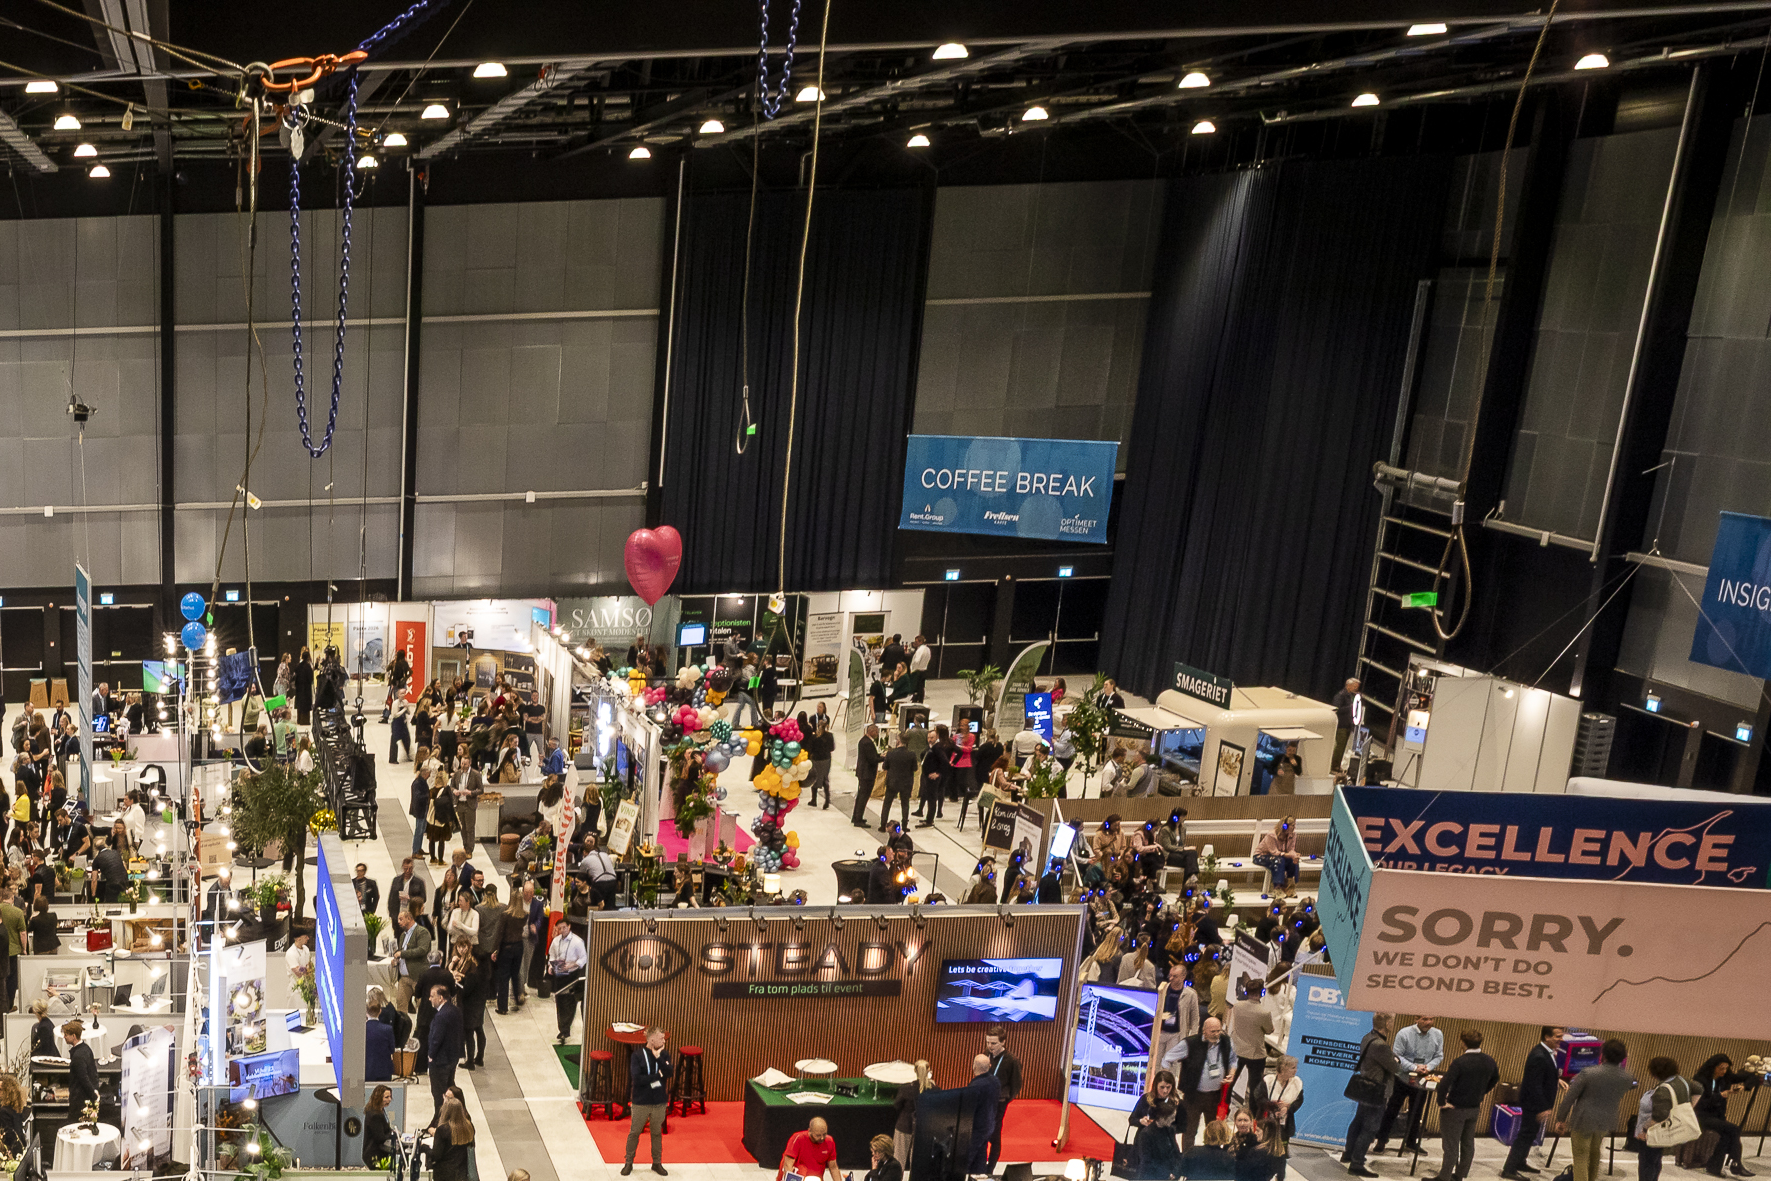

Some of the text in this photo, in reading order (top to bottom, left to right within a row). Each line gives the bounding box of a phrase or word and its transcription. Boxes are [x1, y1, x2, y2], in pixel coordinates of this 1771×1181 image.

[921, 468, 1096, 498] COFFEE BREAK
[1060, 526, 1089, 534] MESSEN
[1061, 519, 1097, 528] OPTIMEET
[1718, 579, 1771, 611] INSIG
[572, 607, 653, 629] SAMSØ
[711, 619, 751, 627] eptionisten
[620, 804, 636, 818] VIND
[1357, 816, 1736, 873] EXCELLENCE
[1377, 905, 1634, 957] SORRY.
[701, 940, 932, 977] STEADY
[1372, 951, 1415, 967] WE
[1513, 958, 1553, 977] DO
[948, 965, 964, 974] Lets
[966, 965, 976, 974] be
[977, 965, 1008, 974] creative
[748, 983, 765, 994] Fra
[767, 984, 787, 994] tom
[790, 983, 819, 997] plads
[834, 984, 864, 994] event
[1308, 986, 1345, 1005] DBT
[1366, 974, 1554, 1000] SECOND BEST.
[1308, 1057, 1356, 1070] KOMPETENC
[1316, 1048, 1353, 1060] NETVÆRK
